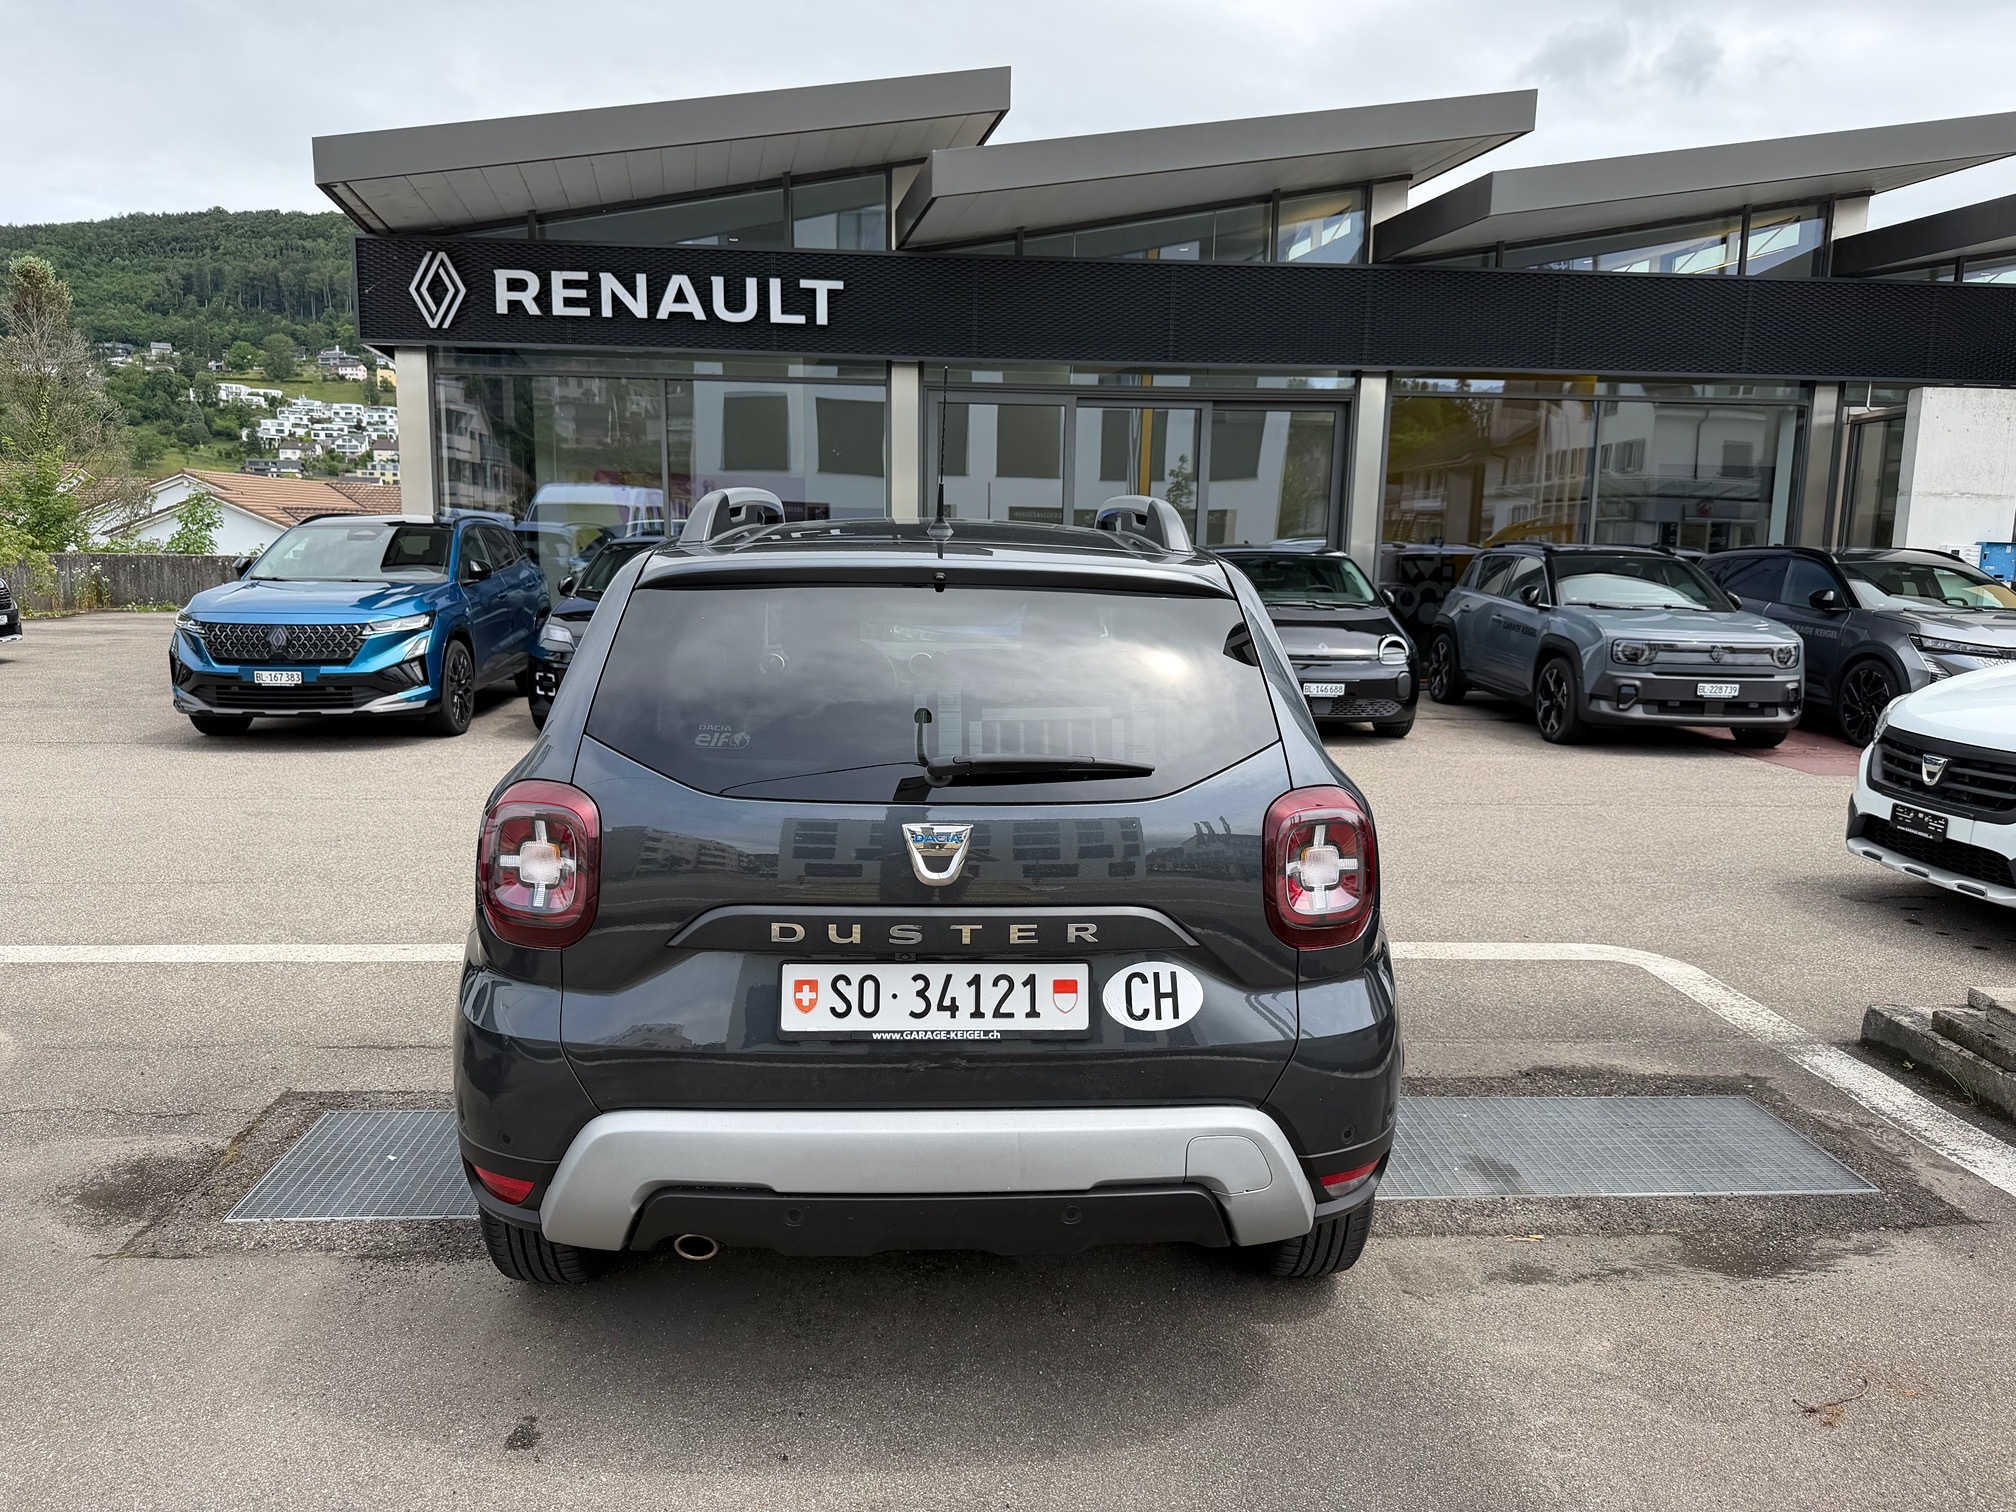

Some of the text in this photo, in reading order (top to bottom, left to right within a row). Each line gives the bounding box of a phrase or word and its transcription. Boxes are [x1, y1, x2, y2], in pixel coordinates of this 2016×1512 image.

[493, 269, 845, 326] RENAULT
[1814, 628, 1838, 639] KEIGEL
[694, 732, 732, 747] elf
[914, 834, 961, 844] DACIA
[771, 922, 1099, 945] DUSTER
[1125, 971, 1180, 1021] CH
[872, 1030, 1001, 1040] www.GARAGE-KEIGEL.ch
